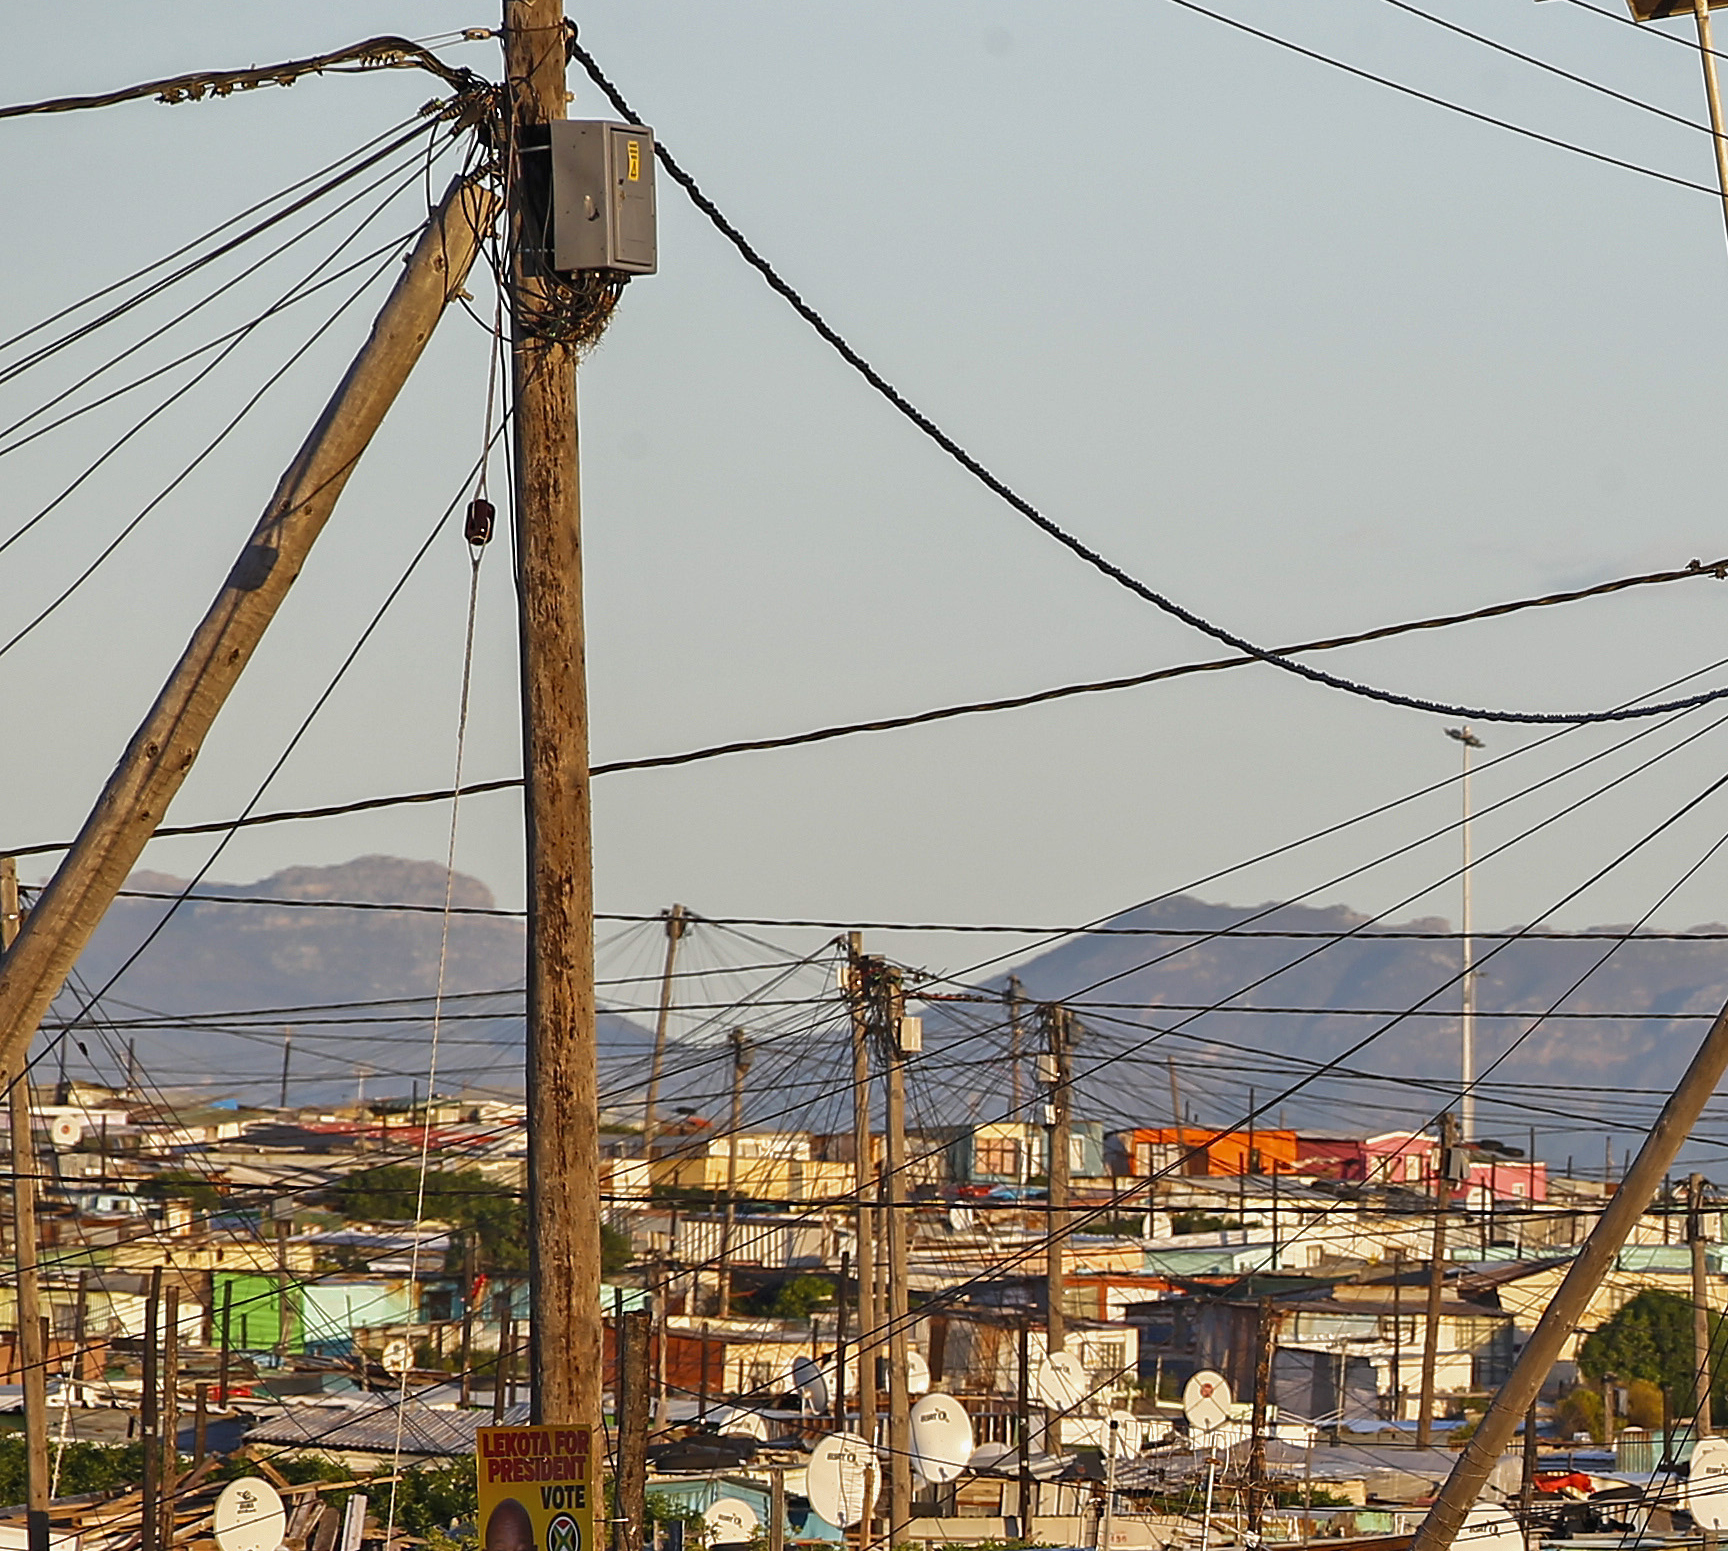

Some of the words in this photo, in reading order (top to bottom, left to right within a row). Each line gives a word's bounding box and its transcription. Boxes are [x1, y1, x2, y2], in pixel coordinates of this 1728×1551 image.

[482, 1431, 552, 1458] LEKOTA
[555, 1430, 590, 1455] FOR
[487, 1455, 587, 1483] PRESIDENT
[540, 1485, 586, 1510] VOTE
